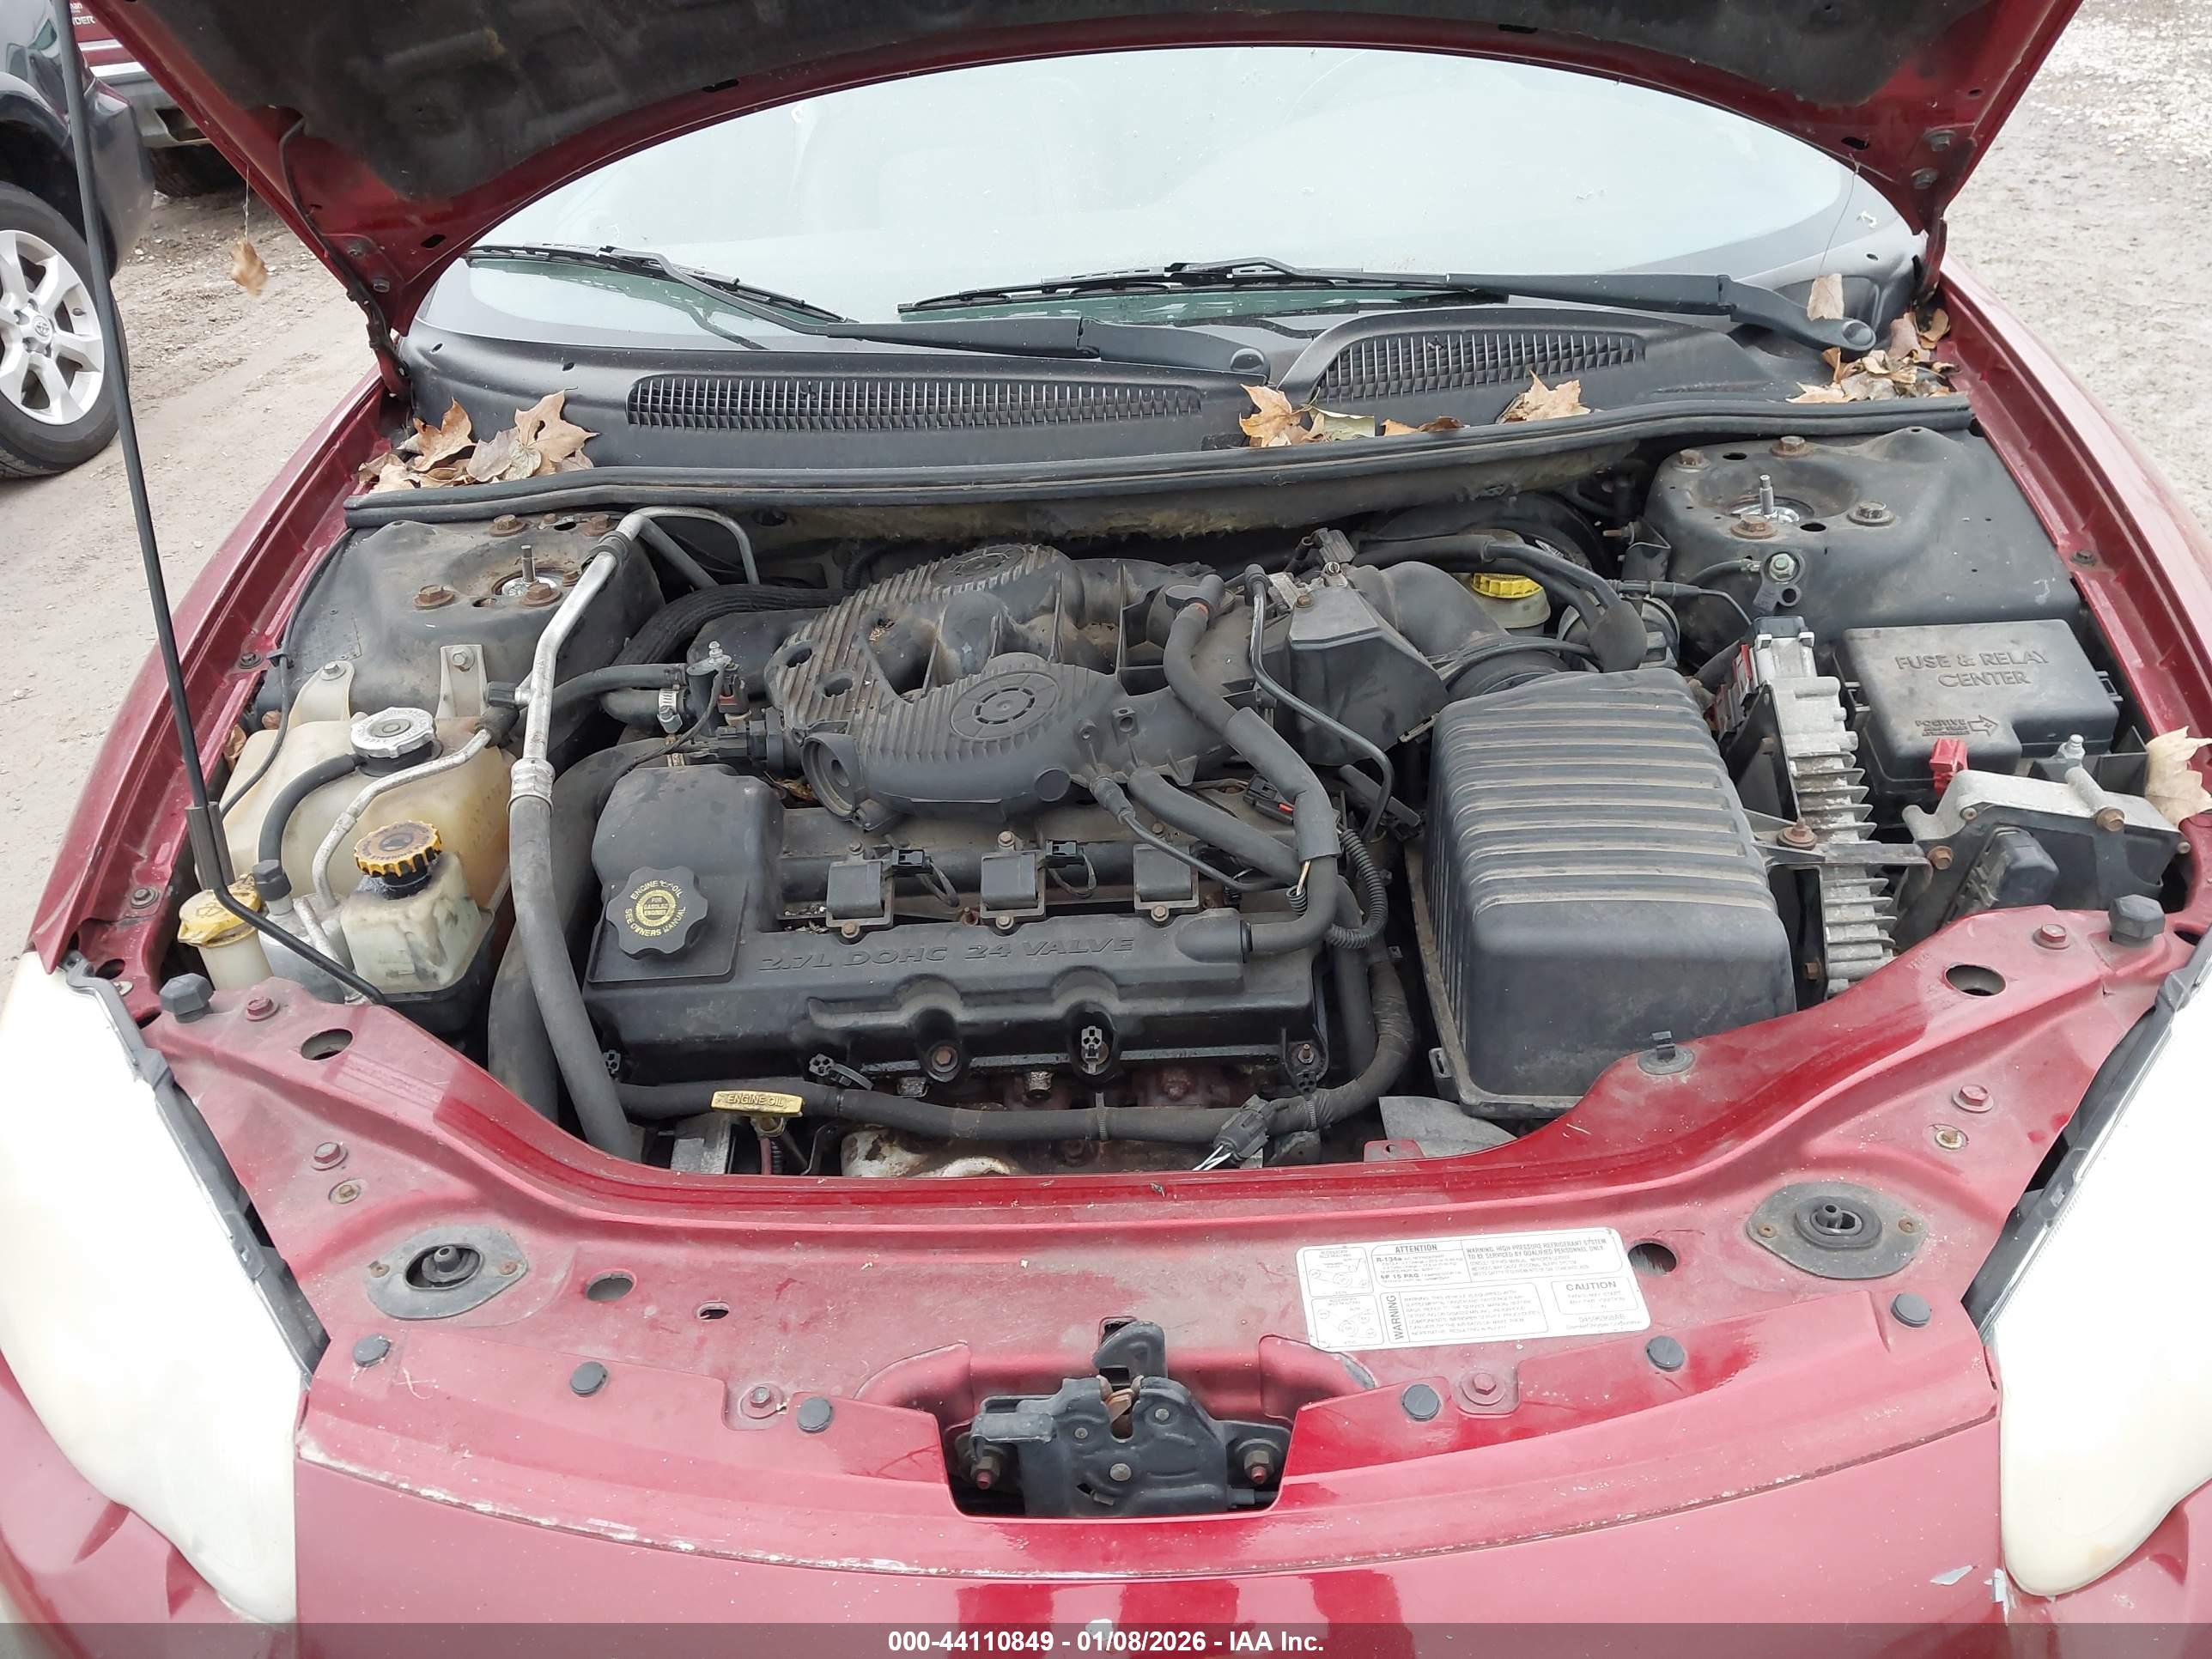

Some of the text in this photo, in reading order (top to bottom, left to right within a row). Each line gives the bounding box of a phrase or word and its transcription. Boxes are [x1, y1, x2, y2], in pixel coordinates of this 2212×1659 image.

[1894, 650, 2050, 670] FUSE & RELAY
[1937, 670, 2032, 688] CENTER
[629, 879, 684, 900] ENGINE OIL
[624, 906, 686, 937] SEE OWNERS MANUAL
[757, 938, 1135, 971] 2.7L DOHC 24 VALVE
[727, 1093, 785, 1107] ENGINE OIL
[1395, 1243, 1437, 1254] ATTENTION
[1511, 1243, 1542, 1251] PRESSURE
[1583, 1237, 1607, 1246] SYSTEM
[1522, 1249, 1553, 1257] QUALIFIED
[1565, 1280, 1618, 1291] CAUTION
[1386, 1295, 1404, 1340] WARNING
